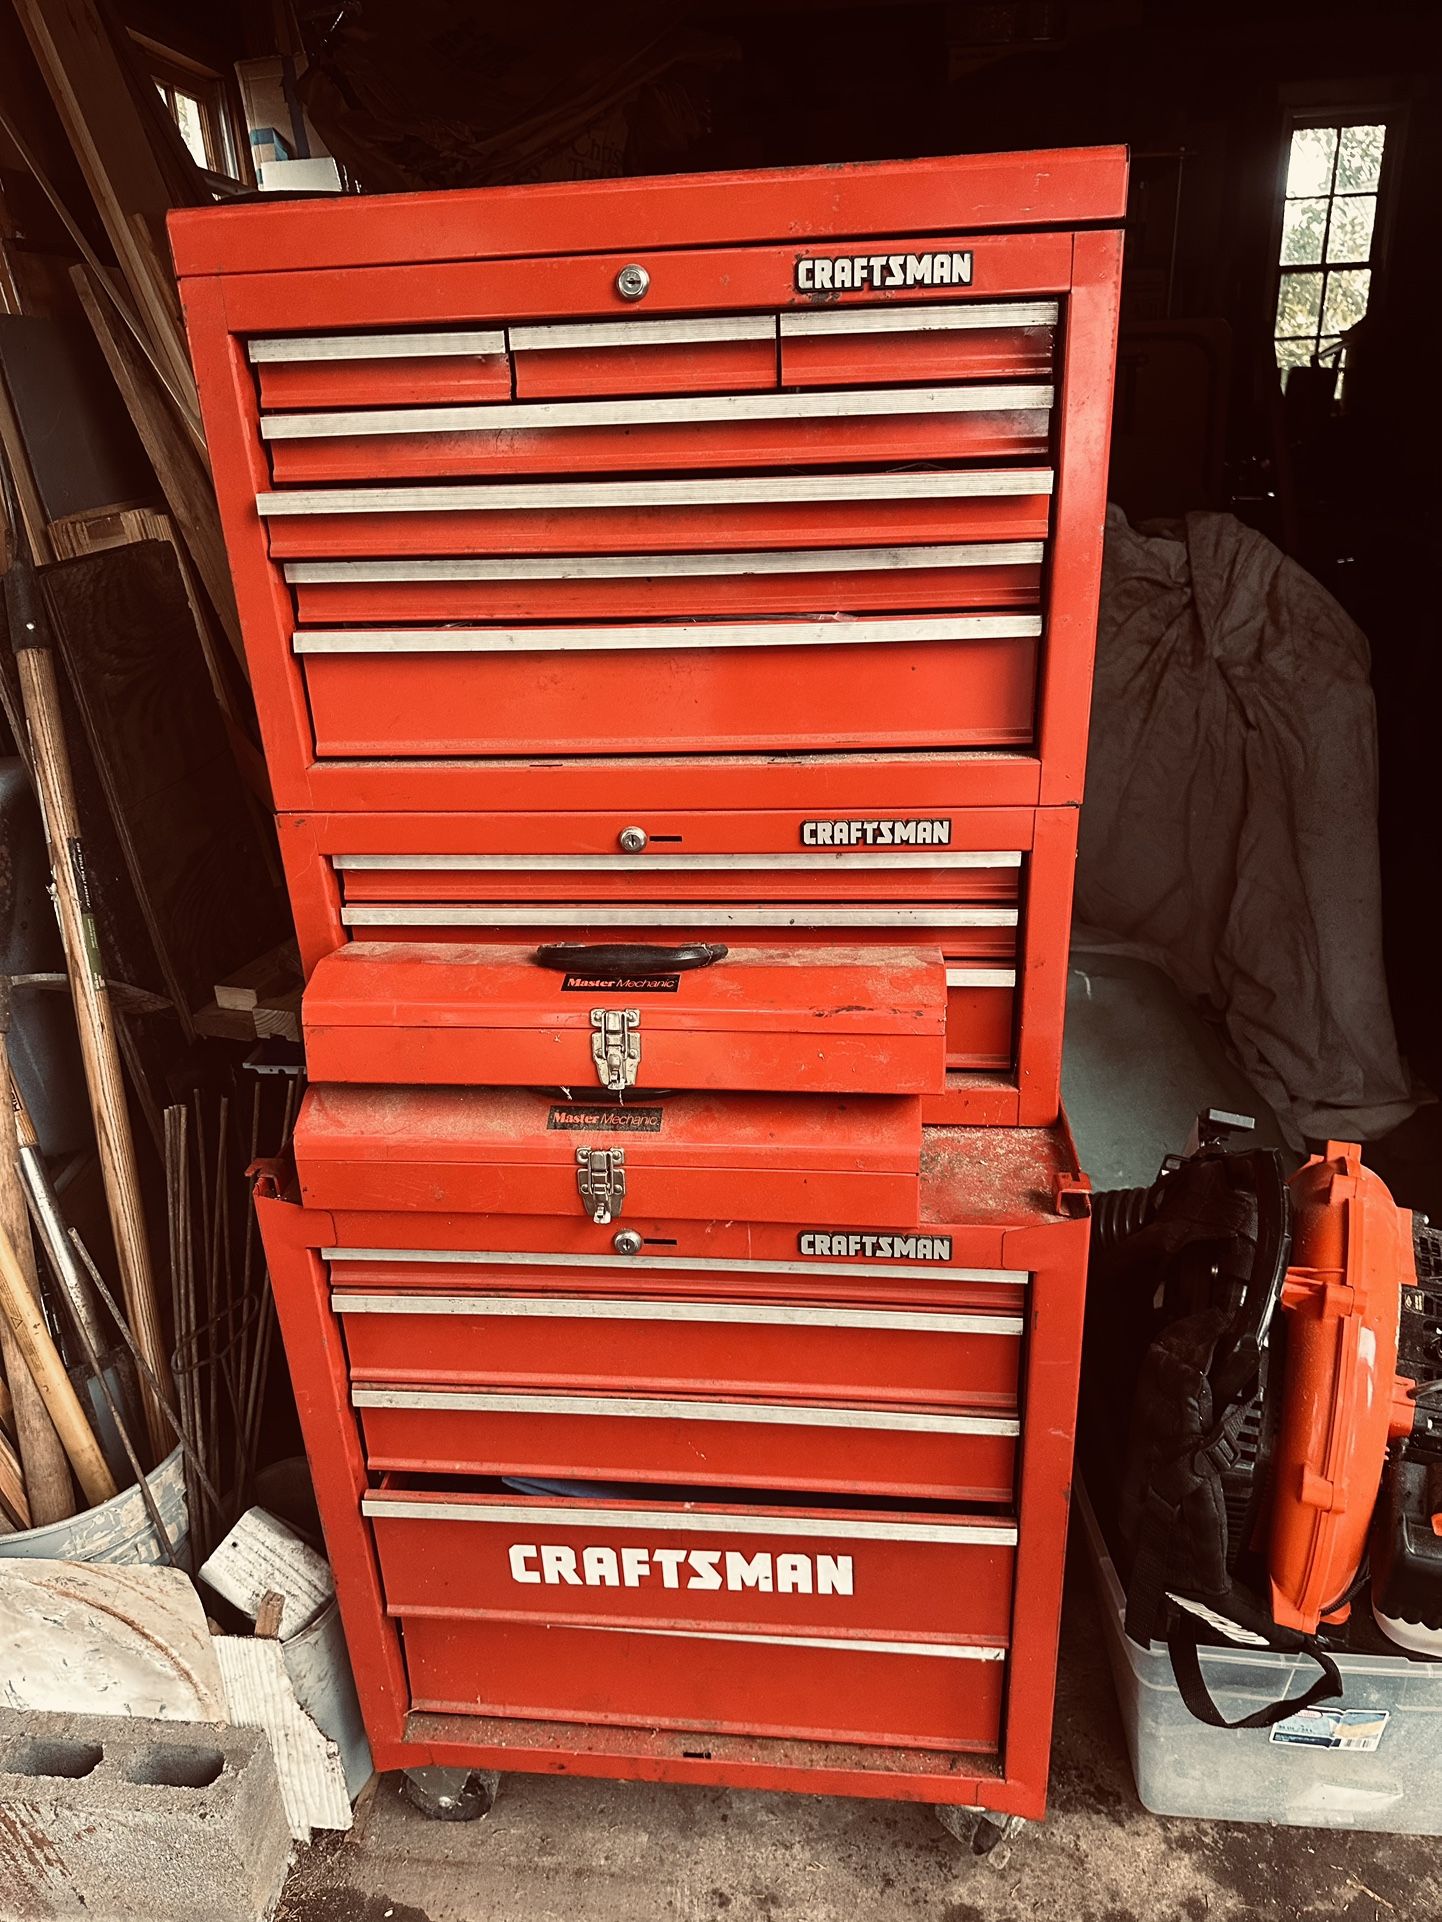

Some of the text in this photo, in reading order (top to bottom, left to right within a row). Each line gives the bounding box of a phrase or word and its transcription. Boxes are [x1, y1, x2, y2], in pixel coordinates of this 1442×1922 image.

[797, 253, 971, 290] CRAFTSMAN
[803, 820, 950, 846] CRAFTSMAN
[567, 978, 675, 989] Master Mechanic
[553, 1112, 658, 1126] Master Mechanic
[801, 1234, 950, 1261] CRAFTSMAN
[508, 1544, 854, 1596] CRAFTSMAN
